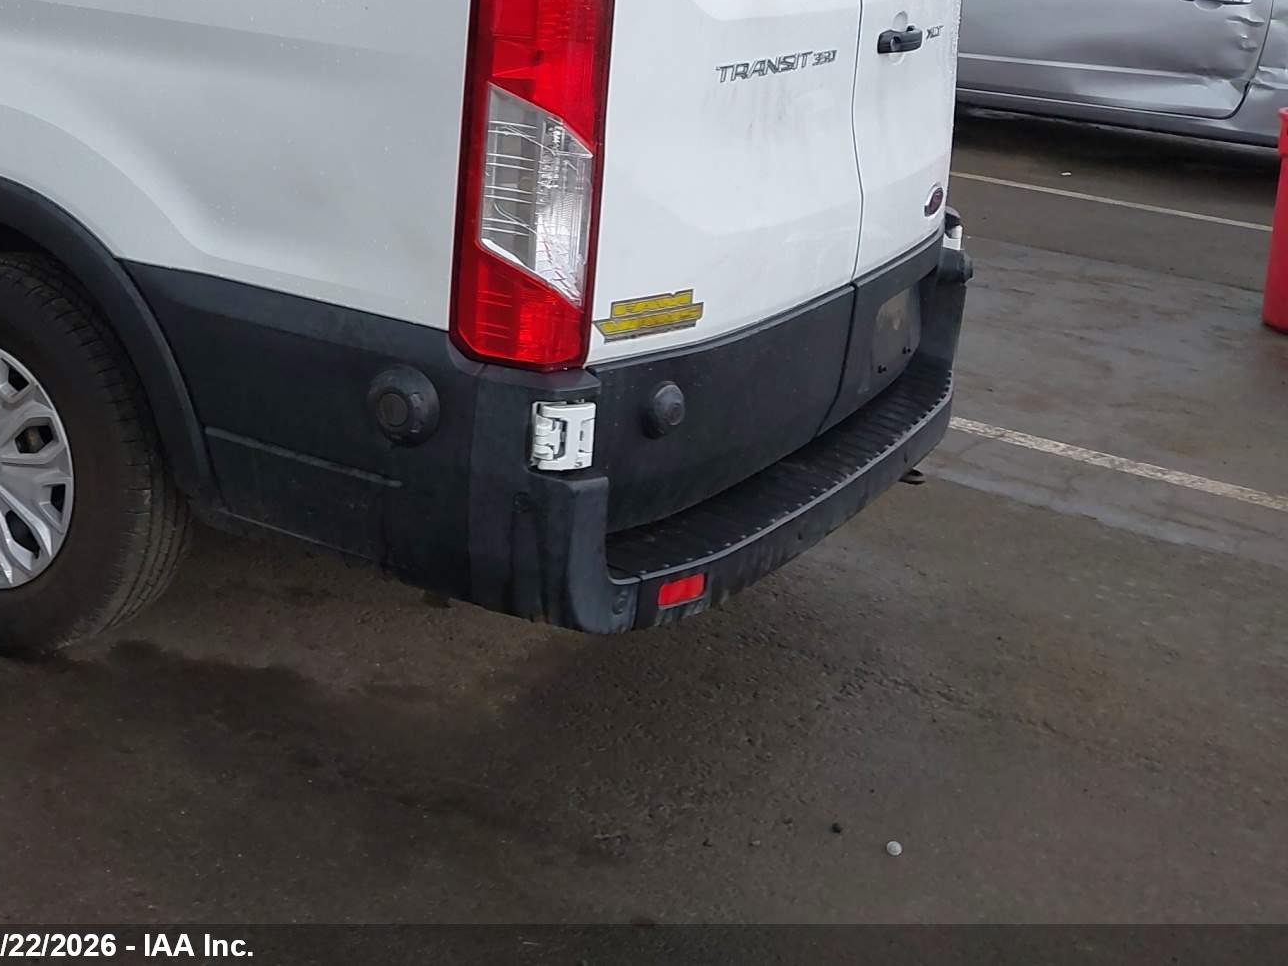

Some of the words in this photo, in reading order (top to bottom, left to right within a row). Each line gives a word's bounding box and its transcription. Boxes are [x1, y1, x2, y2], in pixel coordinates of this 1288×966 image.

[926, 25, 944, 40] XLT
[715, 50, 813, 83] TRANSIT
[812, 49, 838, 66] 350
